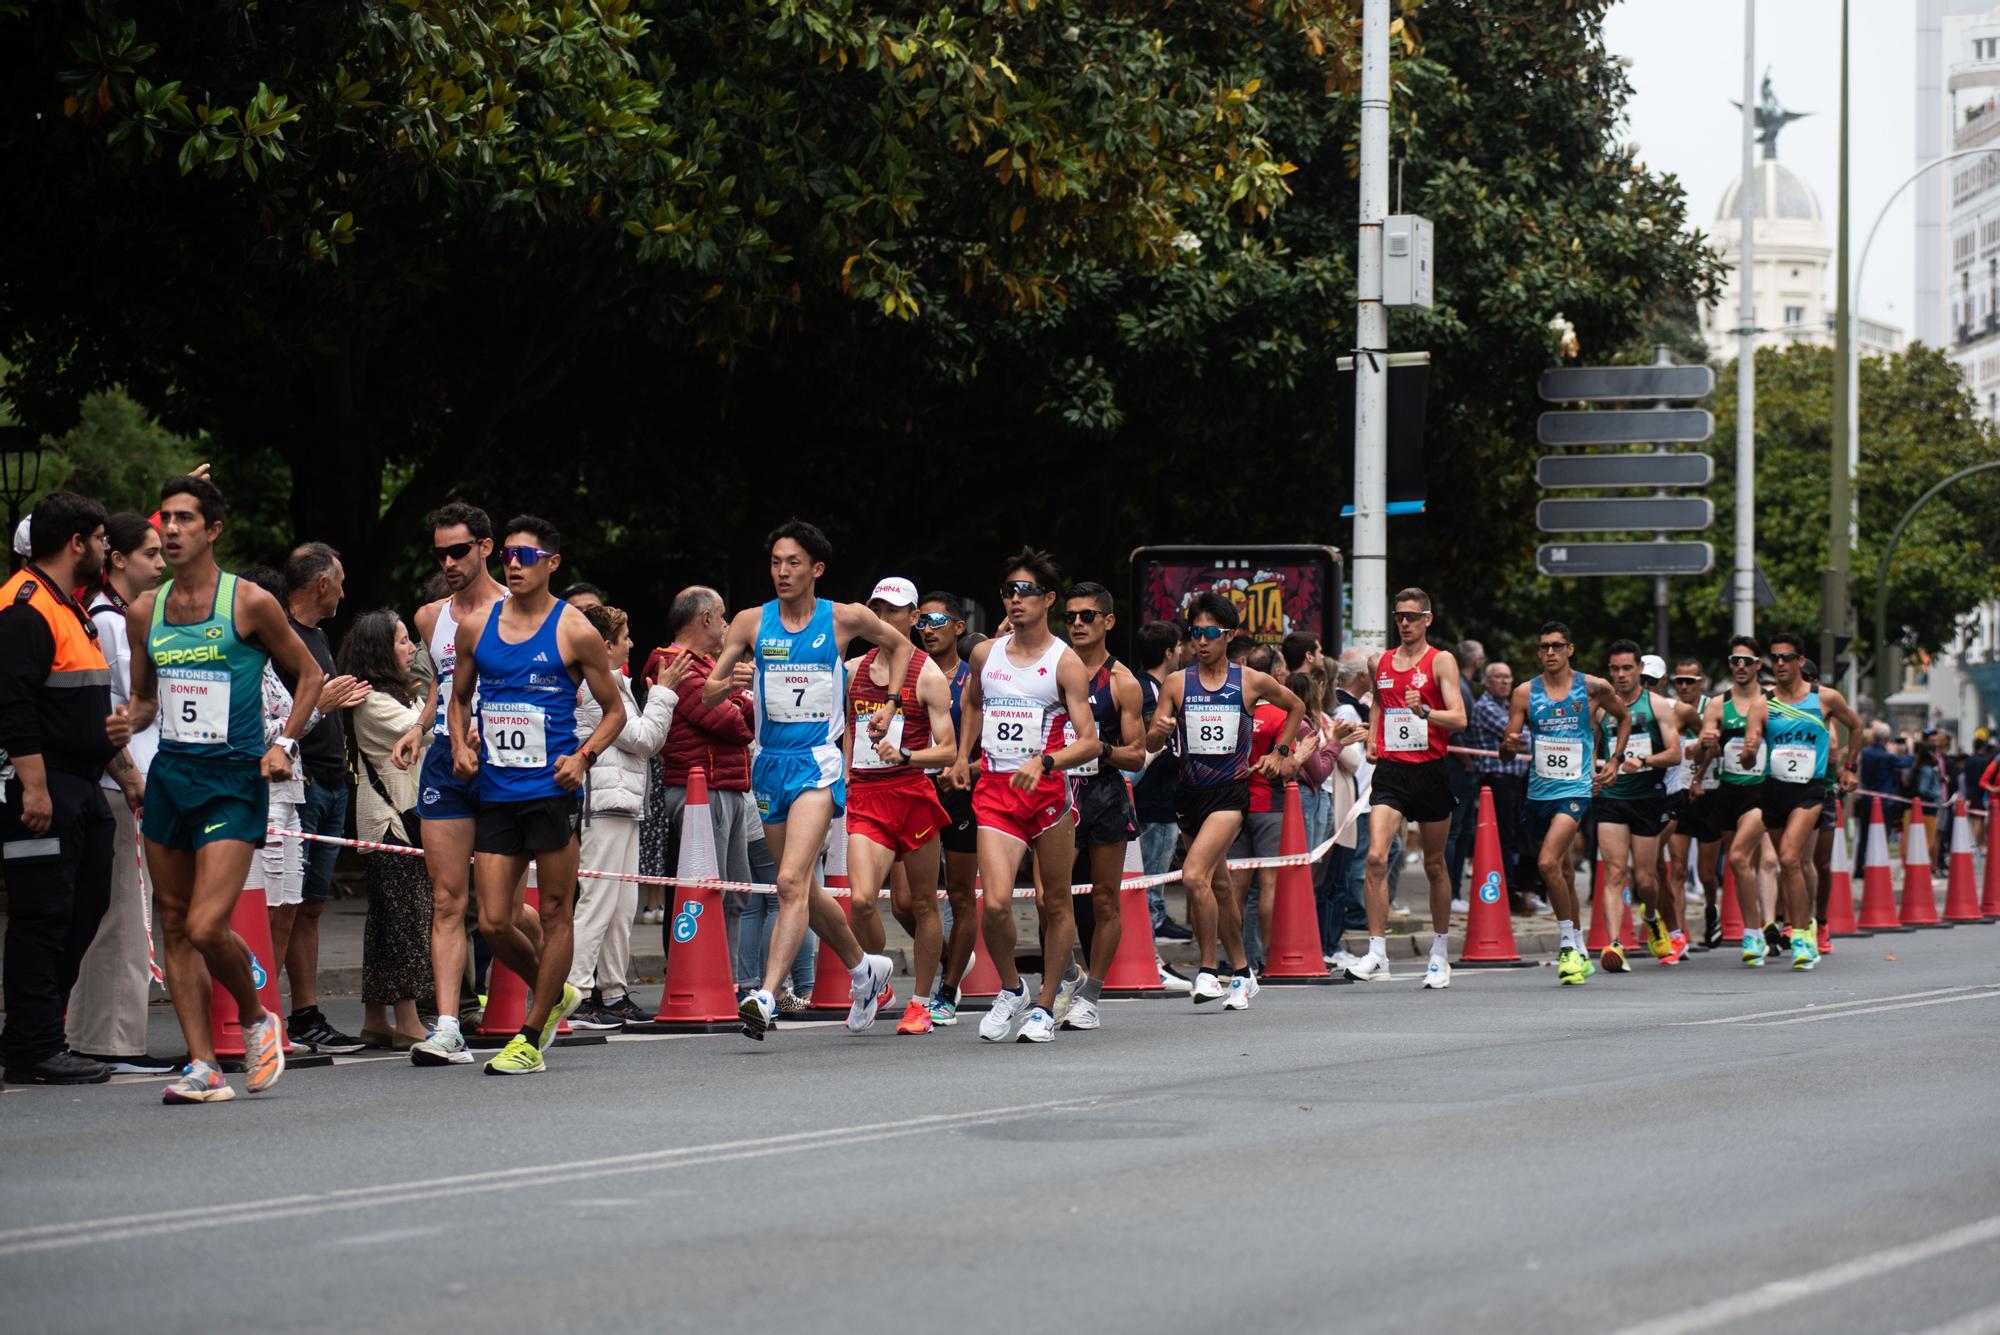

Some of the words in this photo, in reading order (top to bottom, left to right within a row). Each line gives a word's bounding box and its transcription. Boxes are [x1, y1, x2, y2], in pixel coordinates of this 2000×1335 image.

[875, 586, 901, 594] CHINA
[154, 645, 227, 667] BRASIL
[170, 684, 208, 695] BONFIM
[792, 688, 805, 707] 7
[182, 700, 197, 723] 5
[991, 710, 1033, 719] MURAYAMA
[489, 716, 529, 725] HURTADO
[997, 722, 1024, 742] 82
[1200, 726, 1224, 741] 83
[1400, 726, 1409, 739] 8
[495, 730, 526, 751] 10
[1547, 754, 1568, 768] 88
[1787, 760, 1797, 772] 2
